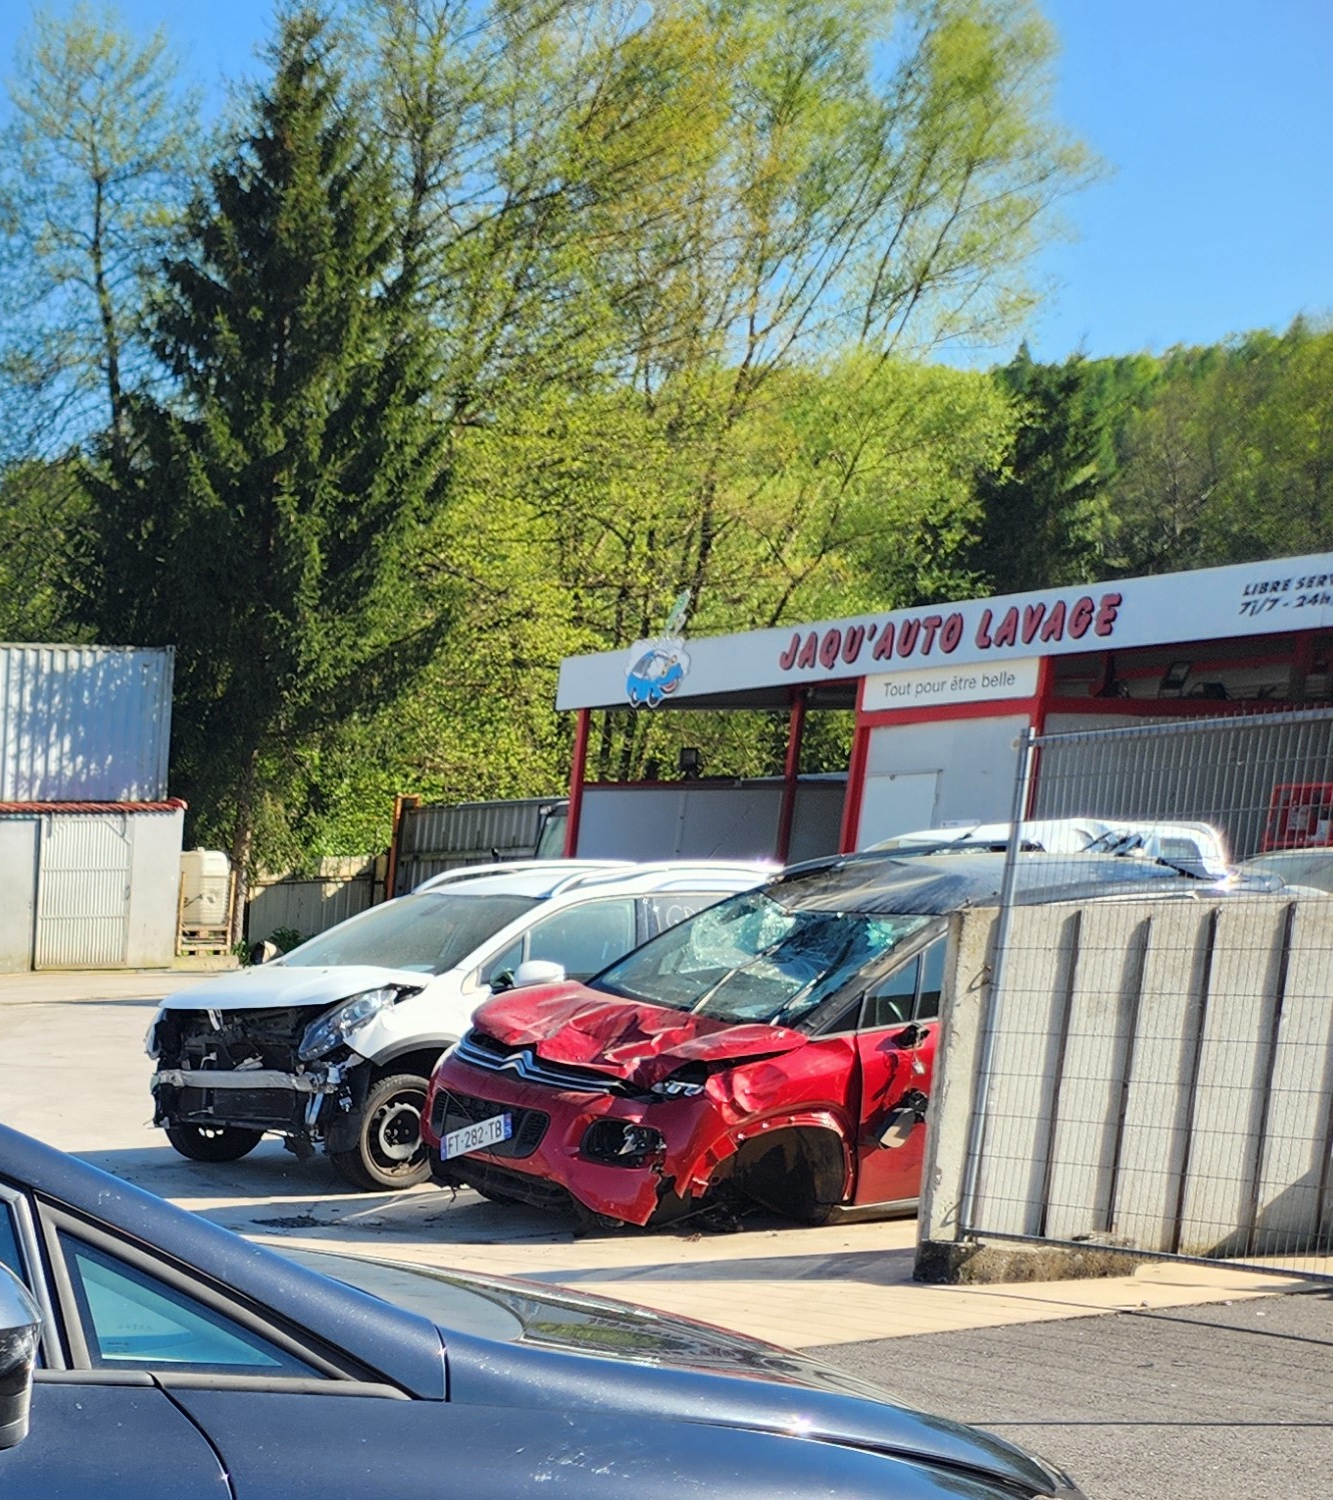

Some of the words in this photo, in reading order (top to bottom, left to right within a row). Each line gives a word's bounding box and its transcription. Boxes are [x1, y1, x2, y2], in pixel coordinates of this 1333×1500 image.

[1241, 578, 1292, 597] LIBRE
[778, 613, 964, 671] JAQU'AUTO
[974, 592, 1123, 649] LAVAGE
[883, 682, 913, 698] Tout
[914, 680, 946, 699] pour
[950, 674, 978, 693] être
[980, 671, 1016, 690] belle
[447, 1119, 503, 1155] FT-282-TB
